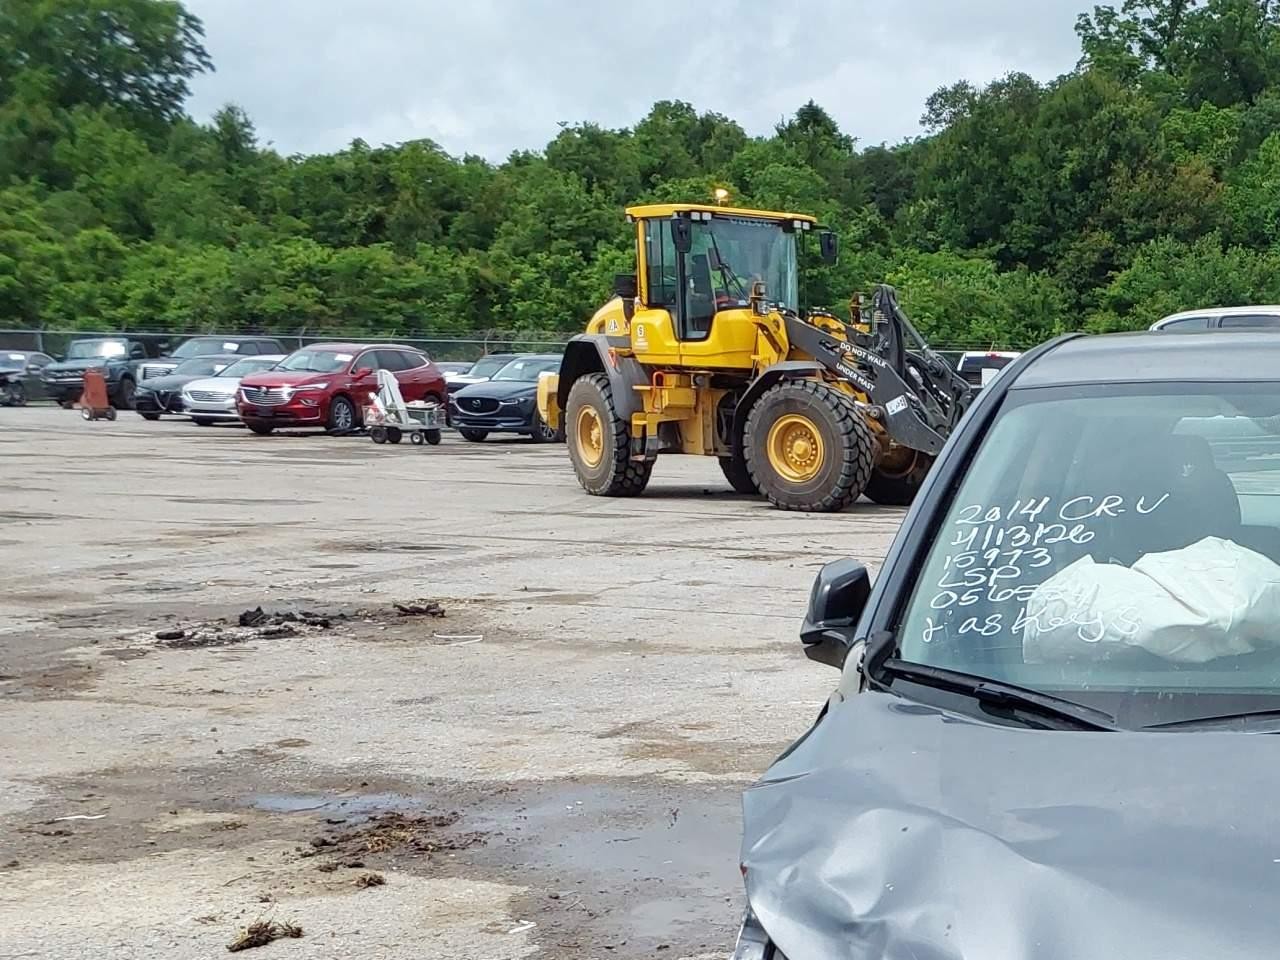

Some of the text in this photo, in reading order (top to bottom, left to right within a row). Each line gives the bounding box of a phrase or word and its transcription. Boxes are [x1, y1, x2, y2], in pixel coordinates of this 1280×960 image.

[840, 342, 887, 368] DO NOT WALK
[836, 362, 876, 391] UNDER MAST
[955, 496, 1050, 525] 2014
